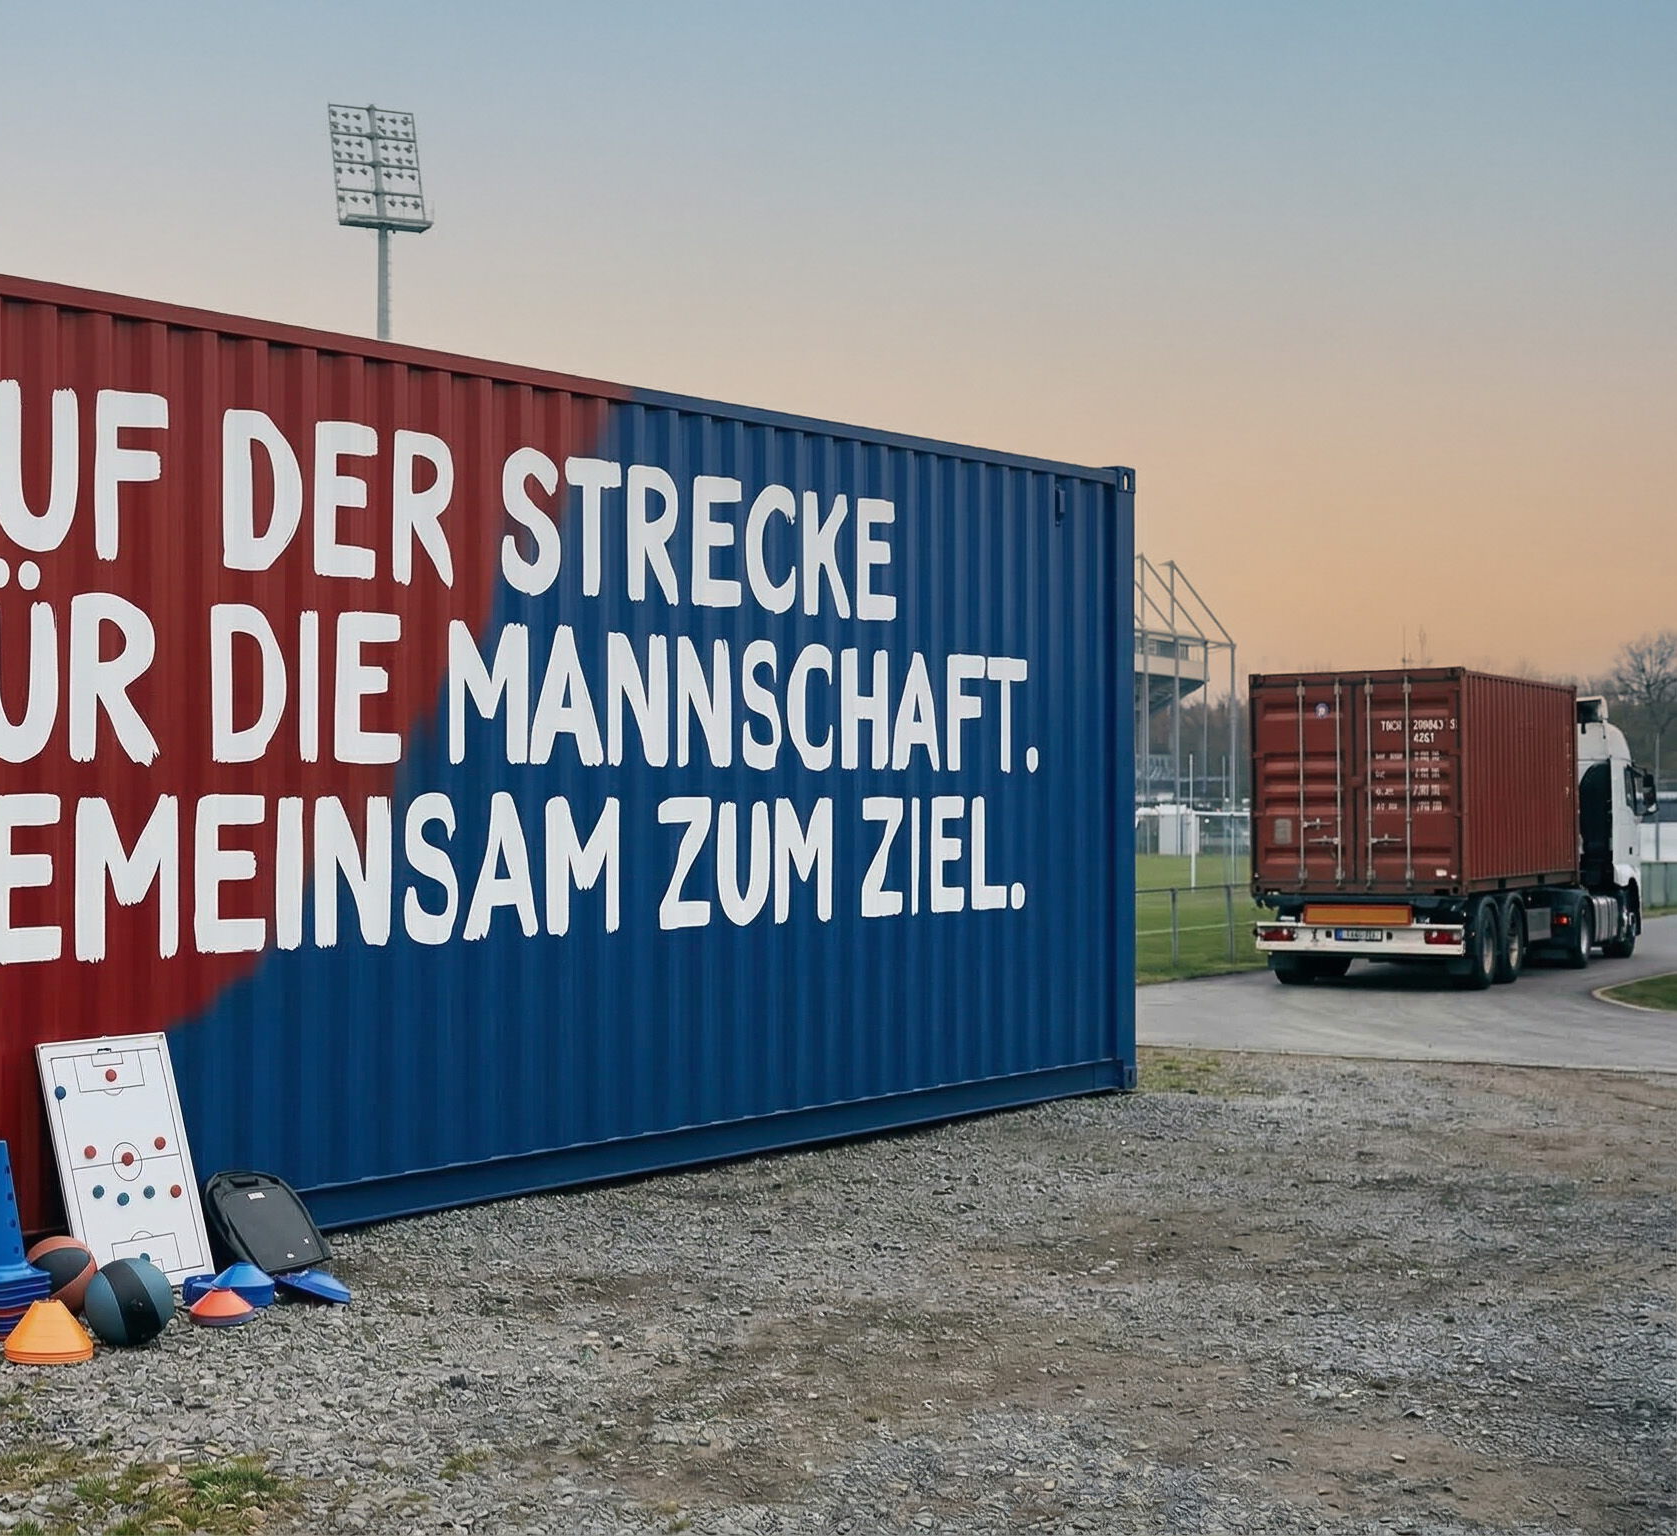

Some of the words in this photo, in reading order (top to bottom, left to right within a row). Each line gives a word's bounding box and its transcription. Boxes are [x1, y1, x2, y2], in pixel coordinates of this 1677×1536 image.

[223, 409, 454, 590] DER
[502, 447, 897, 622] STRECKE
[211, 604, 402, 765] DIE
[449, 620, 1039, 774] MANNSCHAFT.
[658, 797, 833, 930] ZUM
[862, 796, 1026, 918] ZIEL.
